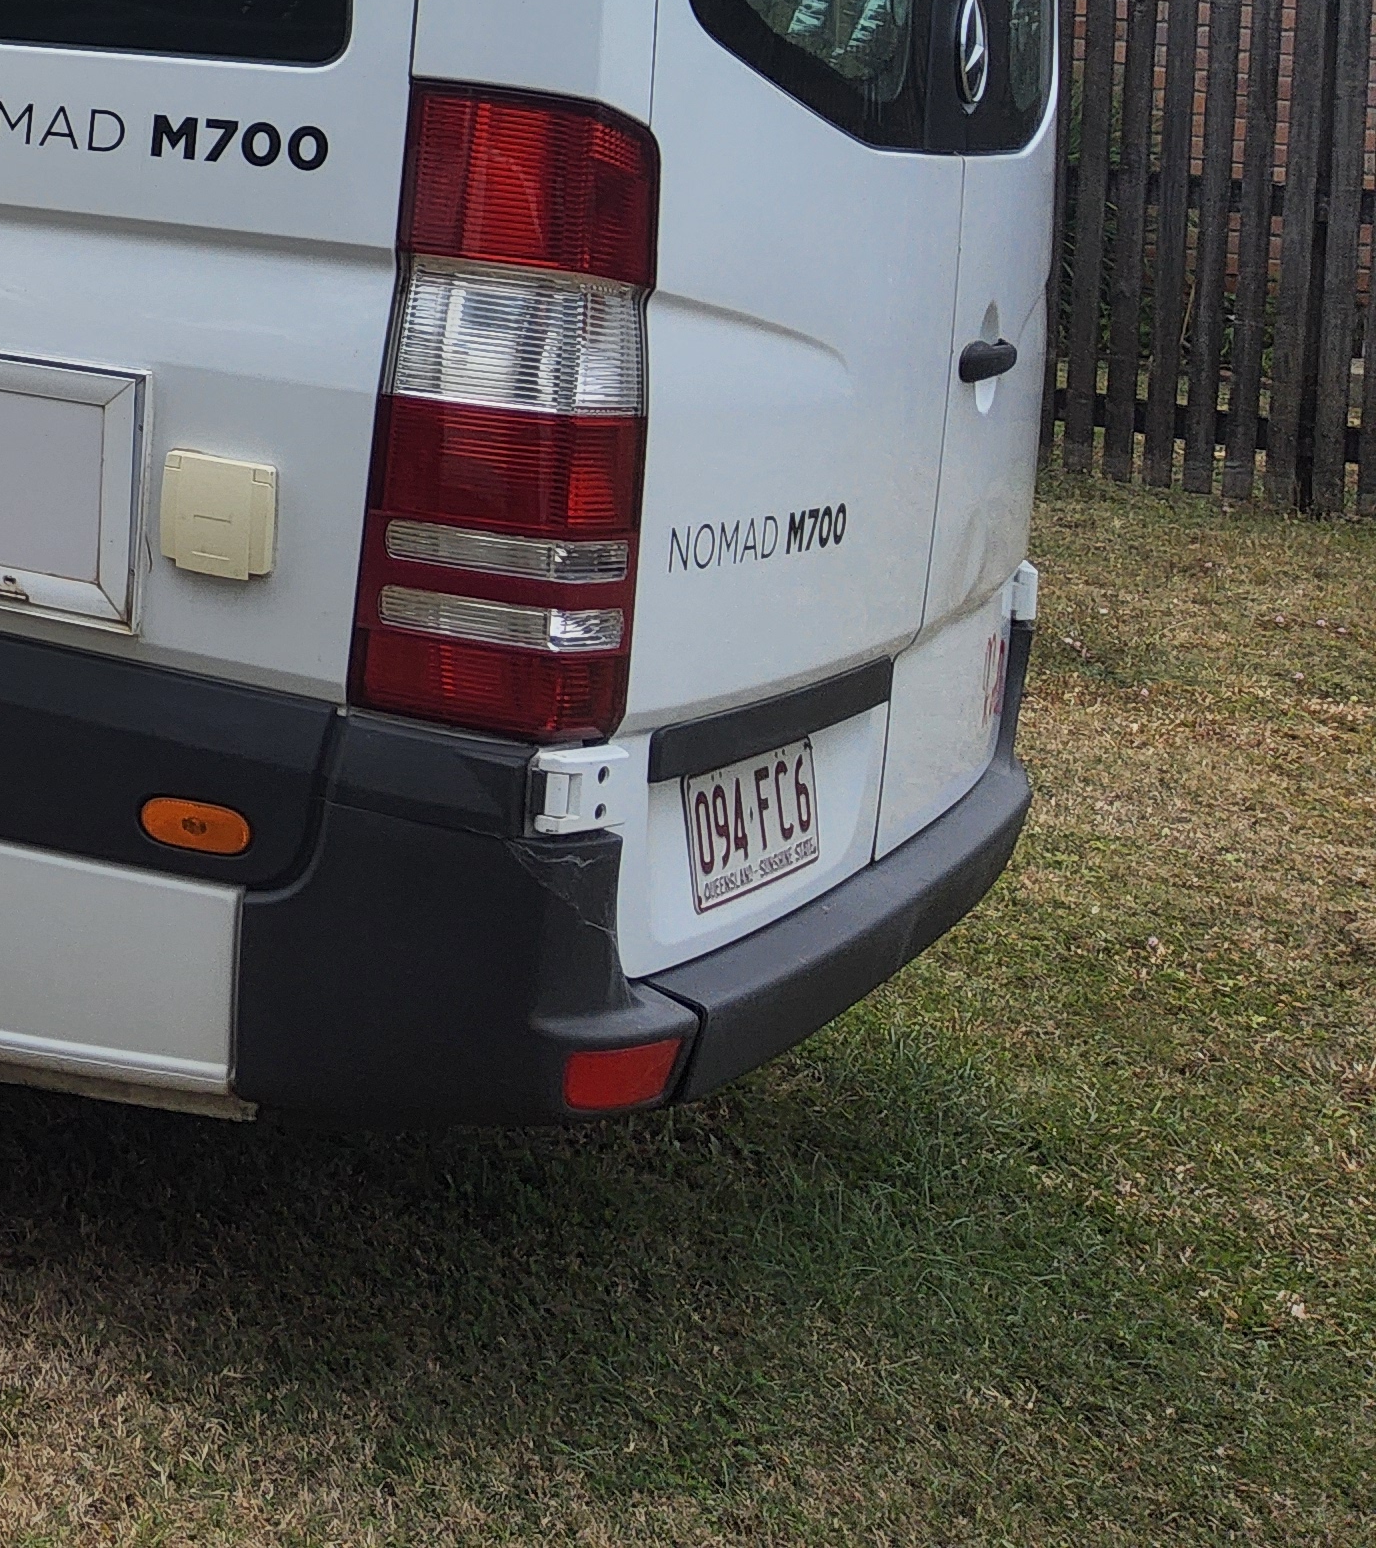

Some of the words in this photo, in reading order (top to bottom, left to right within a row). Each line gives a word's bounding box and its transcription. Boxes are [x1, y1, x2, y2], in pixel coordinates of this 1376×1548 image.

[150, 113, 329, 172] M700
[667, 514, 780, 574] NOMAD
[785, 502, 848, 556] M700
